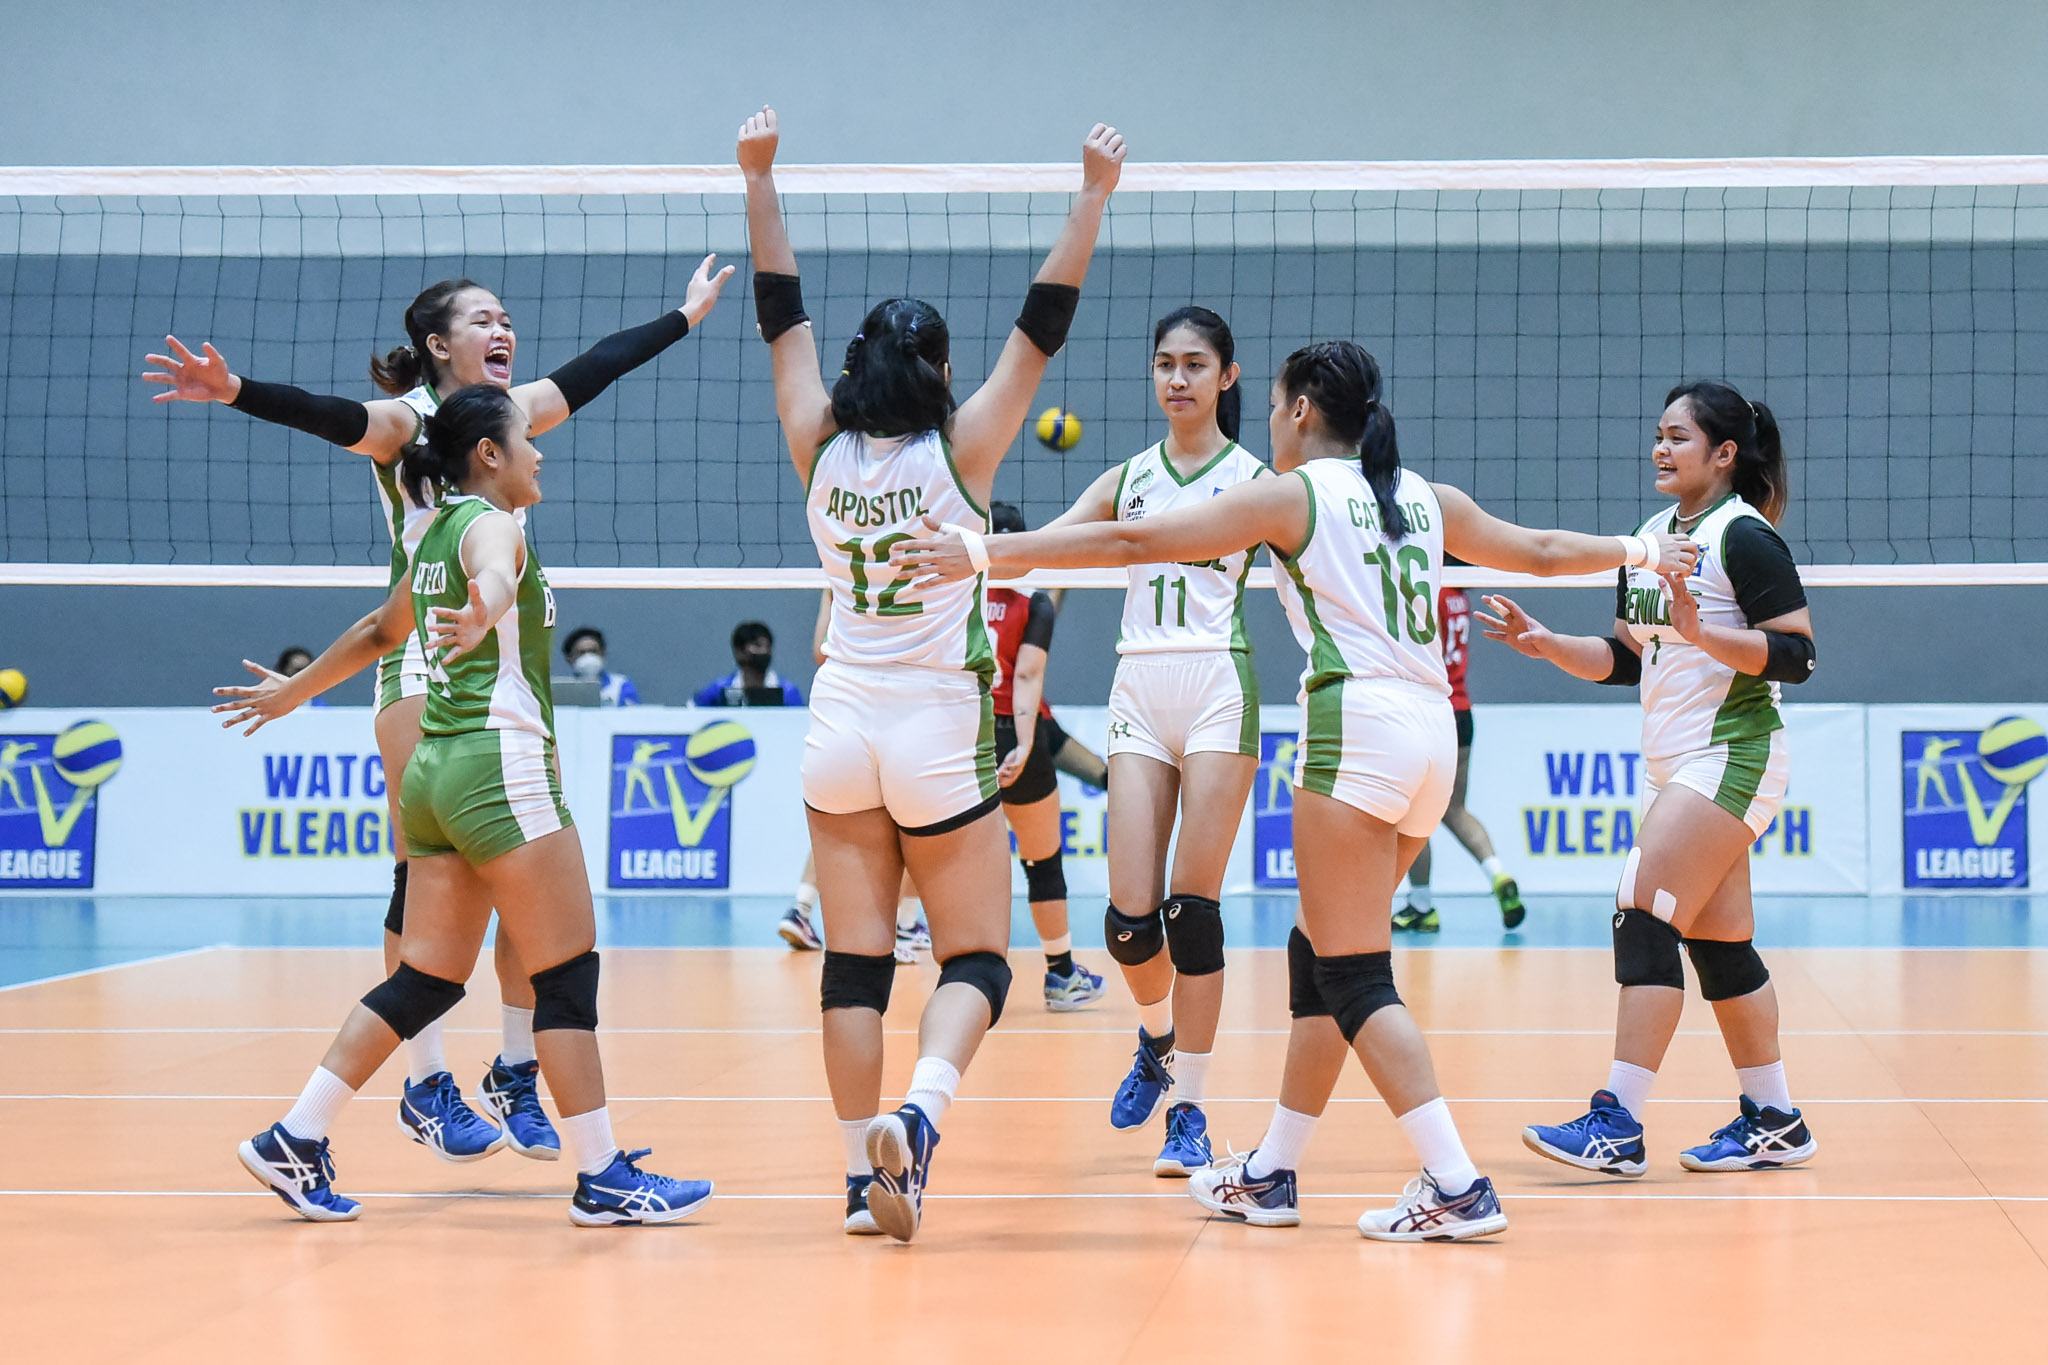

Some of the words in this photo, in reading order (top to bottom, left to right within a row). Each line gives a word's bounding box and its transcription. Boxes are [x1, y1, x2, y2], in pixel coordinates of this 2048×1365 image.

[825, 485, 930, 527] APOSTOL
[1347, 497, 1431, 533] CATBIG
[834, 532, 924, 617] 12
[1363, 542, 1437, 646] 16
[1148, 574, 1186, 627] 11
[263, 755, 387, 798] WATC
[1546, 752, 1641, 796] WAT
[239, 810, 396, 857] VLEAG
[0, 849, 82, 879] EAGUE
[620, 849, 717, 879] LEAGUE
[1916, 848, 2015, 879] LEAGUE
